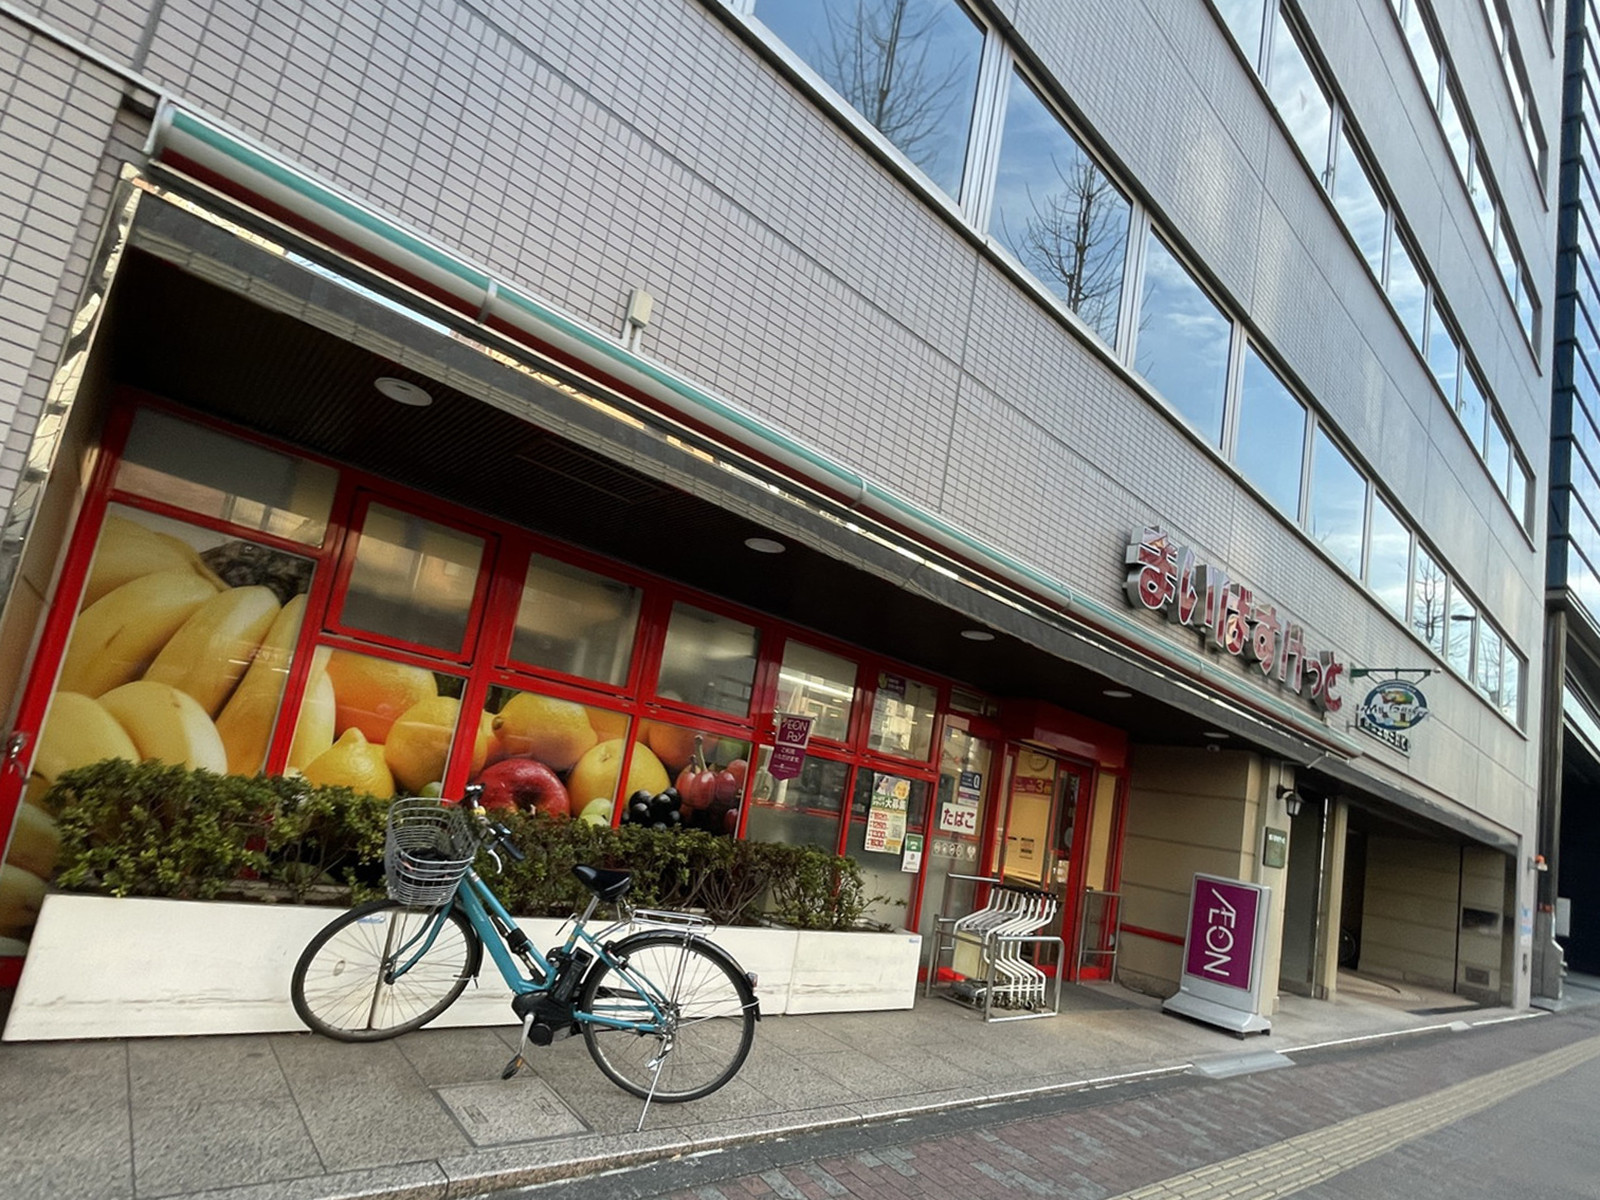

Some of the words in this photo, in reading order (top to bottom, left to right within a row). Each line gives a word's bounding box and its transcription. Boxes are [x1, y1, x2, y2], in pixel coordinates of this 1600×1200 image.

[1129, 526, 1343, 712] まいばすけっと
[786, 731, 805, 742] Pay
[944, 808, 975, 829] たばこ
